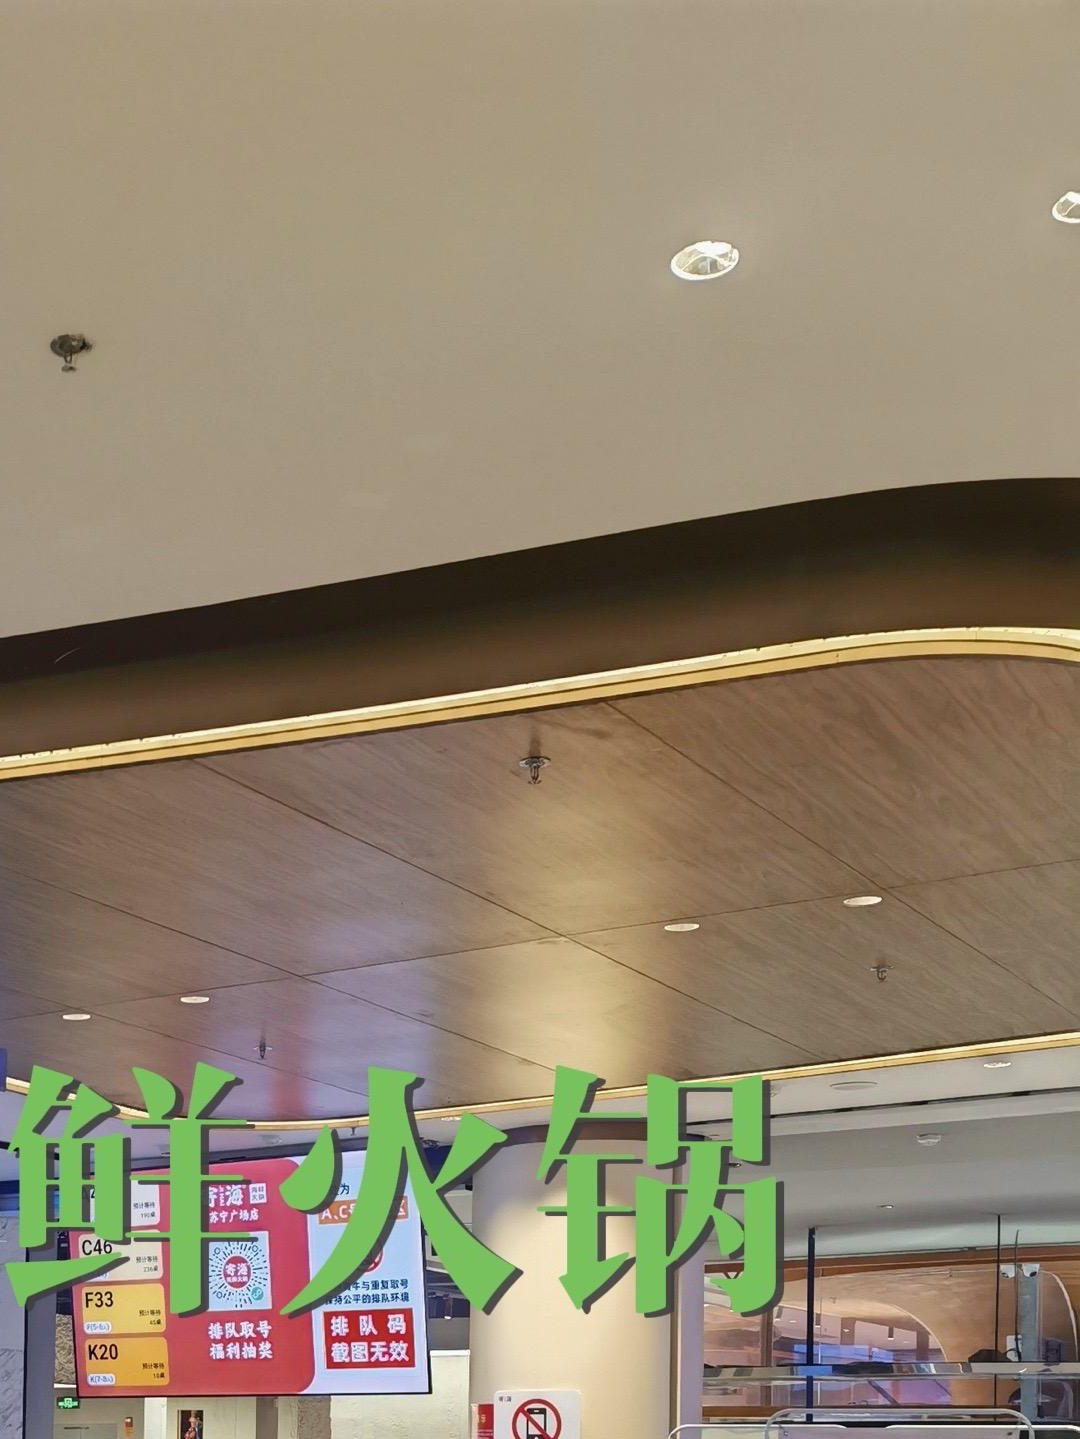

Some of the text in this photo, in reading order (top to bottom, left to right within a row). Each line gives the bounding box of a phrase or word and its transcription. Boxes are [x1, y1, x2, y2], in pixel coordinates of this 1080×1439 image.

[82, 1239, 113, 1256] C46
[348, 1278, 409, 1291] 牛与重复取号
[85, 1291, 114, 1308] F33
[208, 1320, 272, 1340] 排队取号
[88, 1343, 118, 1360] K20
[209, 1342, 273, 1360] 福利抽奖
[330, 1340, 409, 1363] 截图无效
